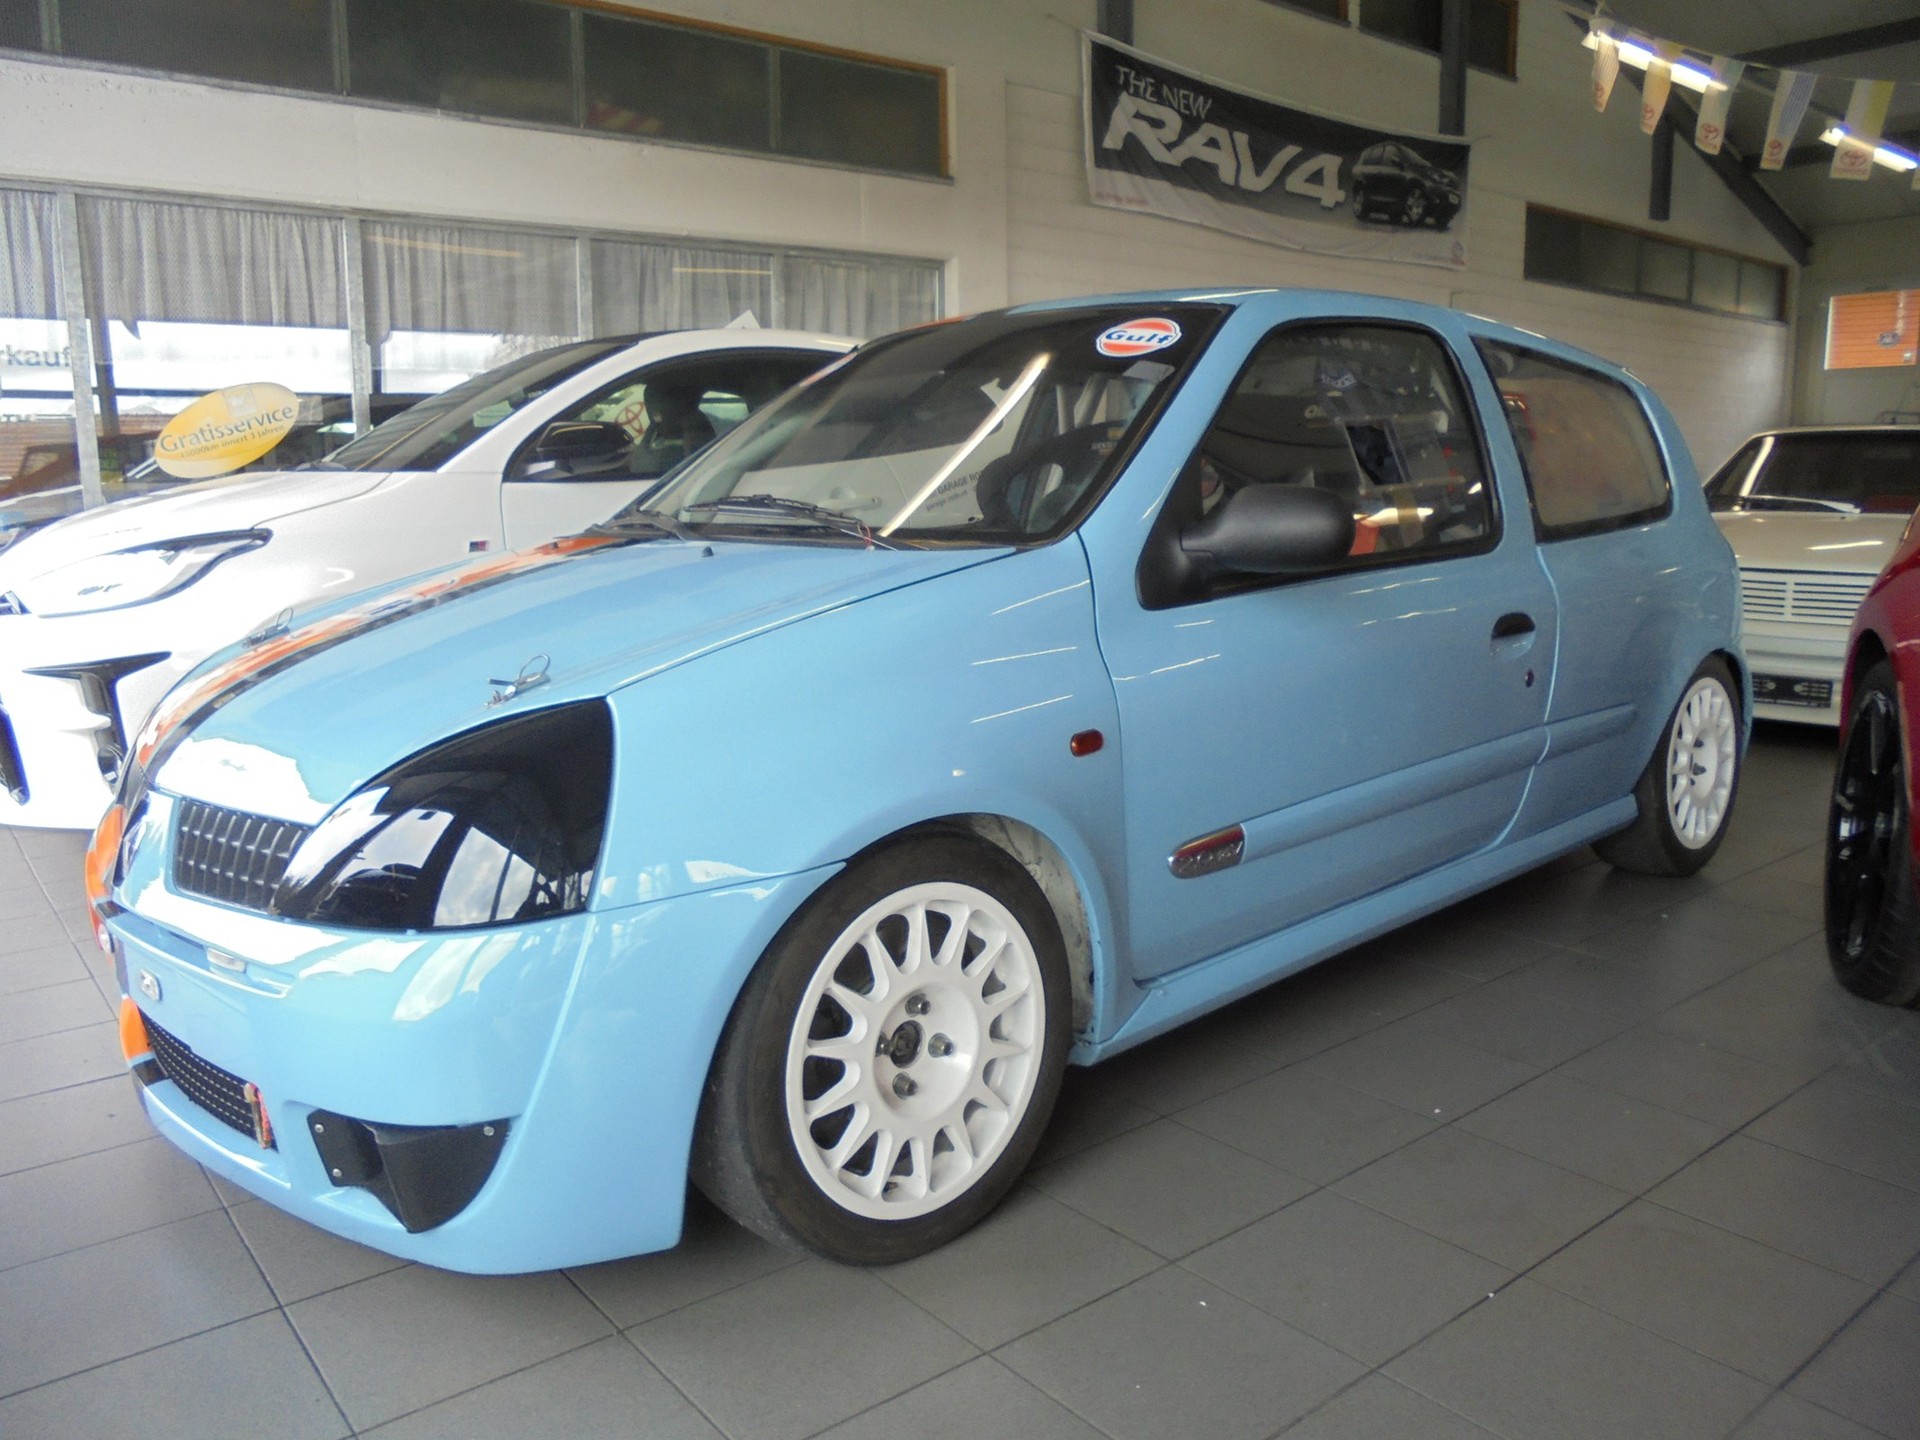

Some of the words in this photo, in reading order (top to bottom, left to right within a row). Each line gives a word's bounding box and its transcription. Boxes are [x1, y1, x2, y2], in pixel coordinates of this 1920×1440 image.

[1116, 65, 1157, 103] THE
[1161, 90, 1213, 119] NEW
[1102, 90, 1347, 209] RAV4
[1105, 329, 1174, 344] Gulf
[160, 406, 294, 453] Gratisservice
[937, 476, 968, 495] GARAGE
